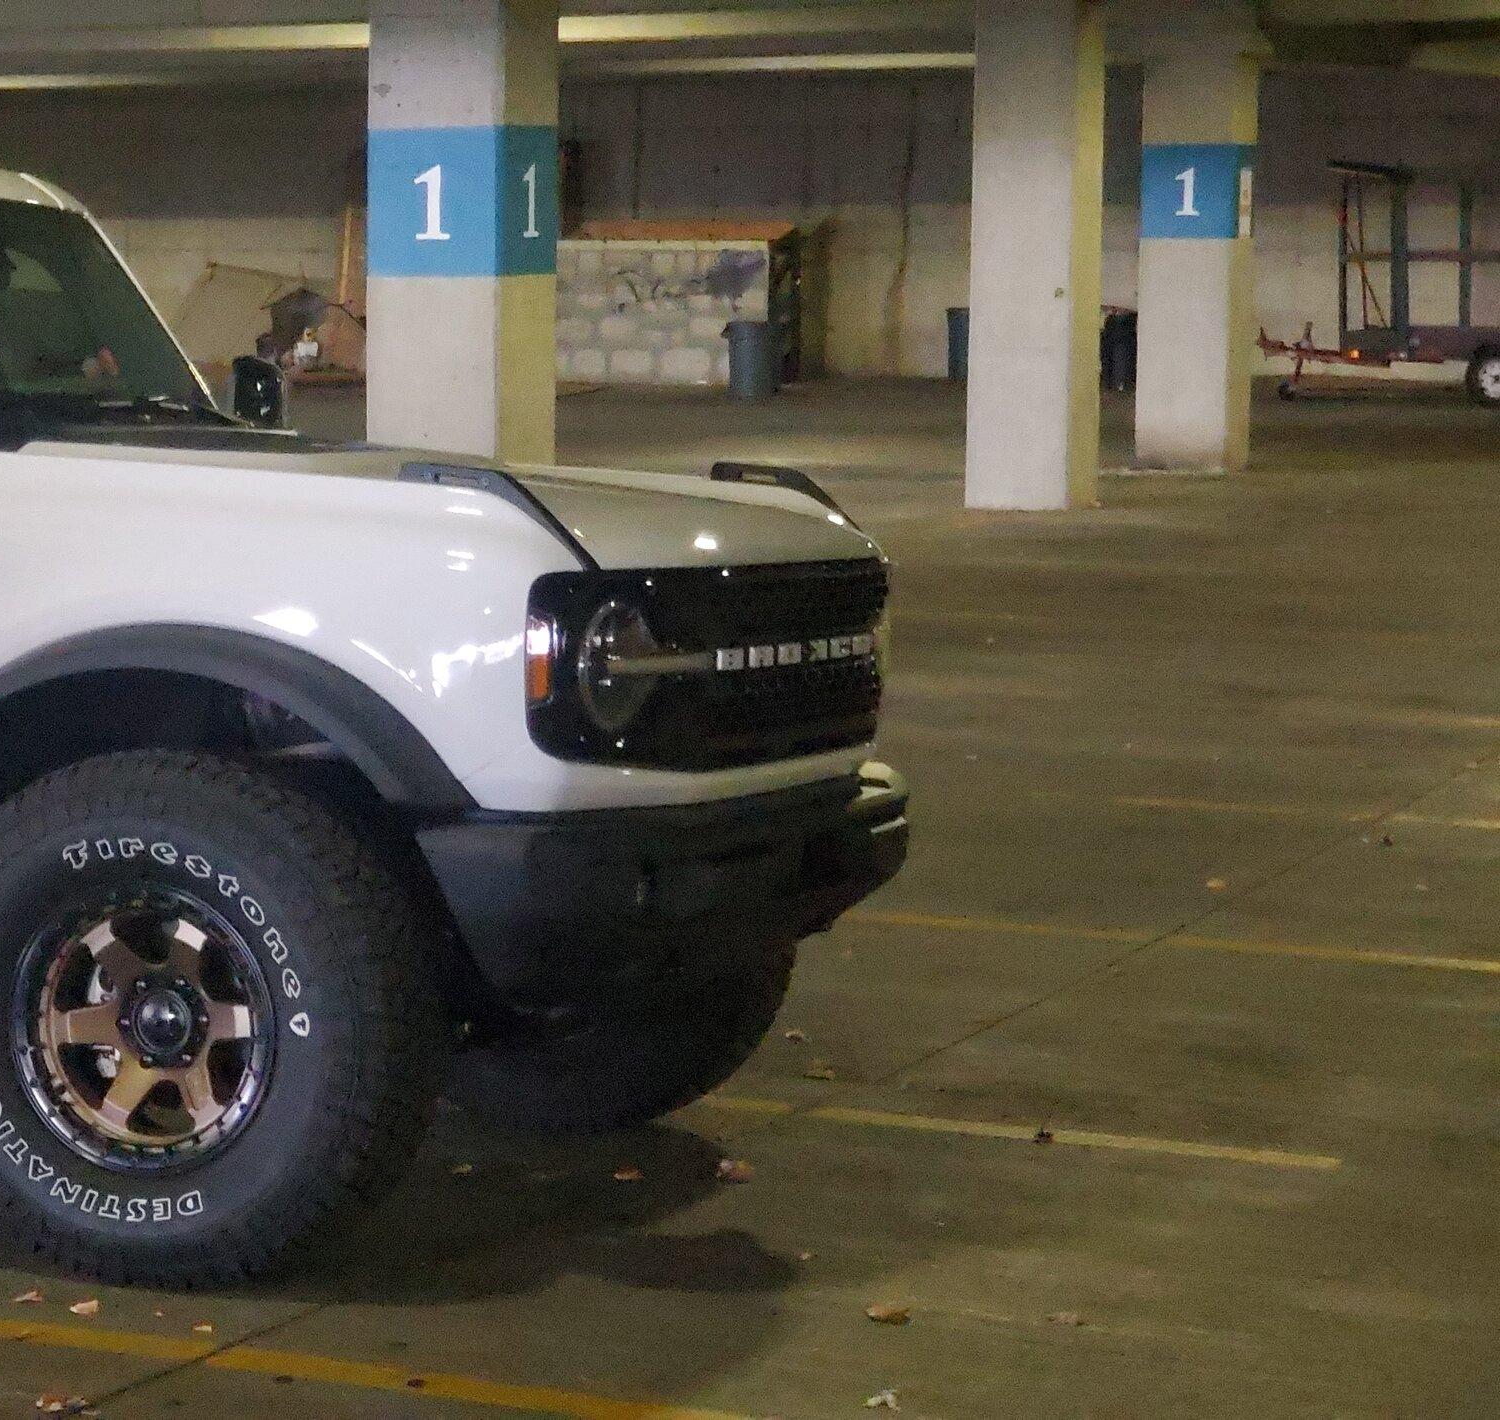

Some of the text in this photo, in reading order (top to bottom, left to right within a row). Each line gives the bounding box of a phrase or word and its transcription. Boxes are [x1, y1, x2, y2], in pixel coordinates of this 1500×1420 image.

[413, 163, 451, 241] 1
[521, 162, 541, 239] 1
[1174, 166, 1200, 217] 1
